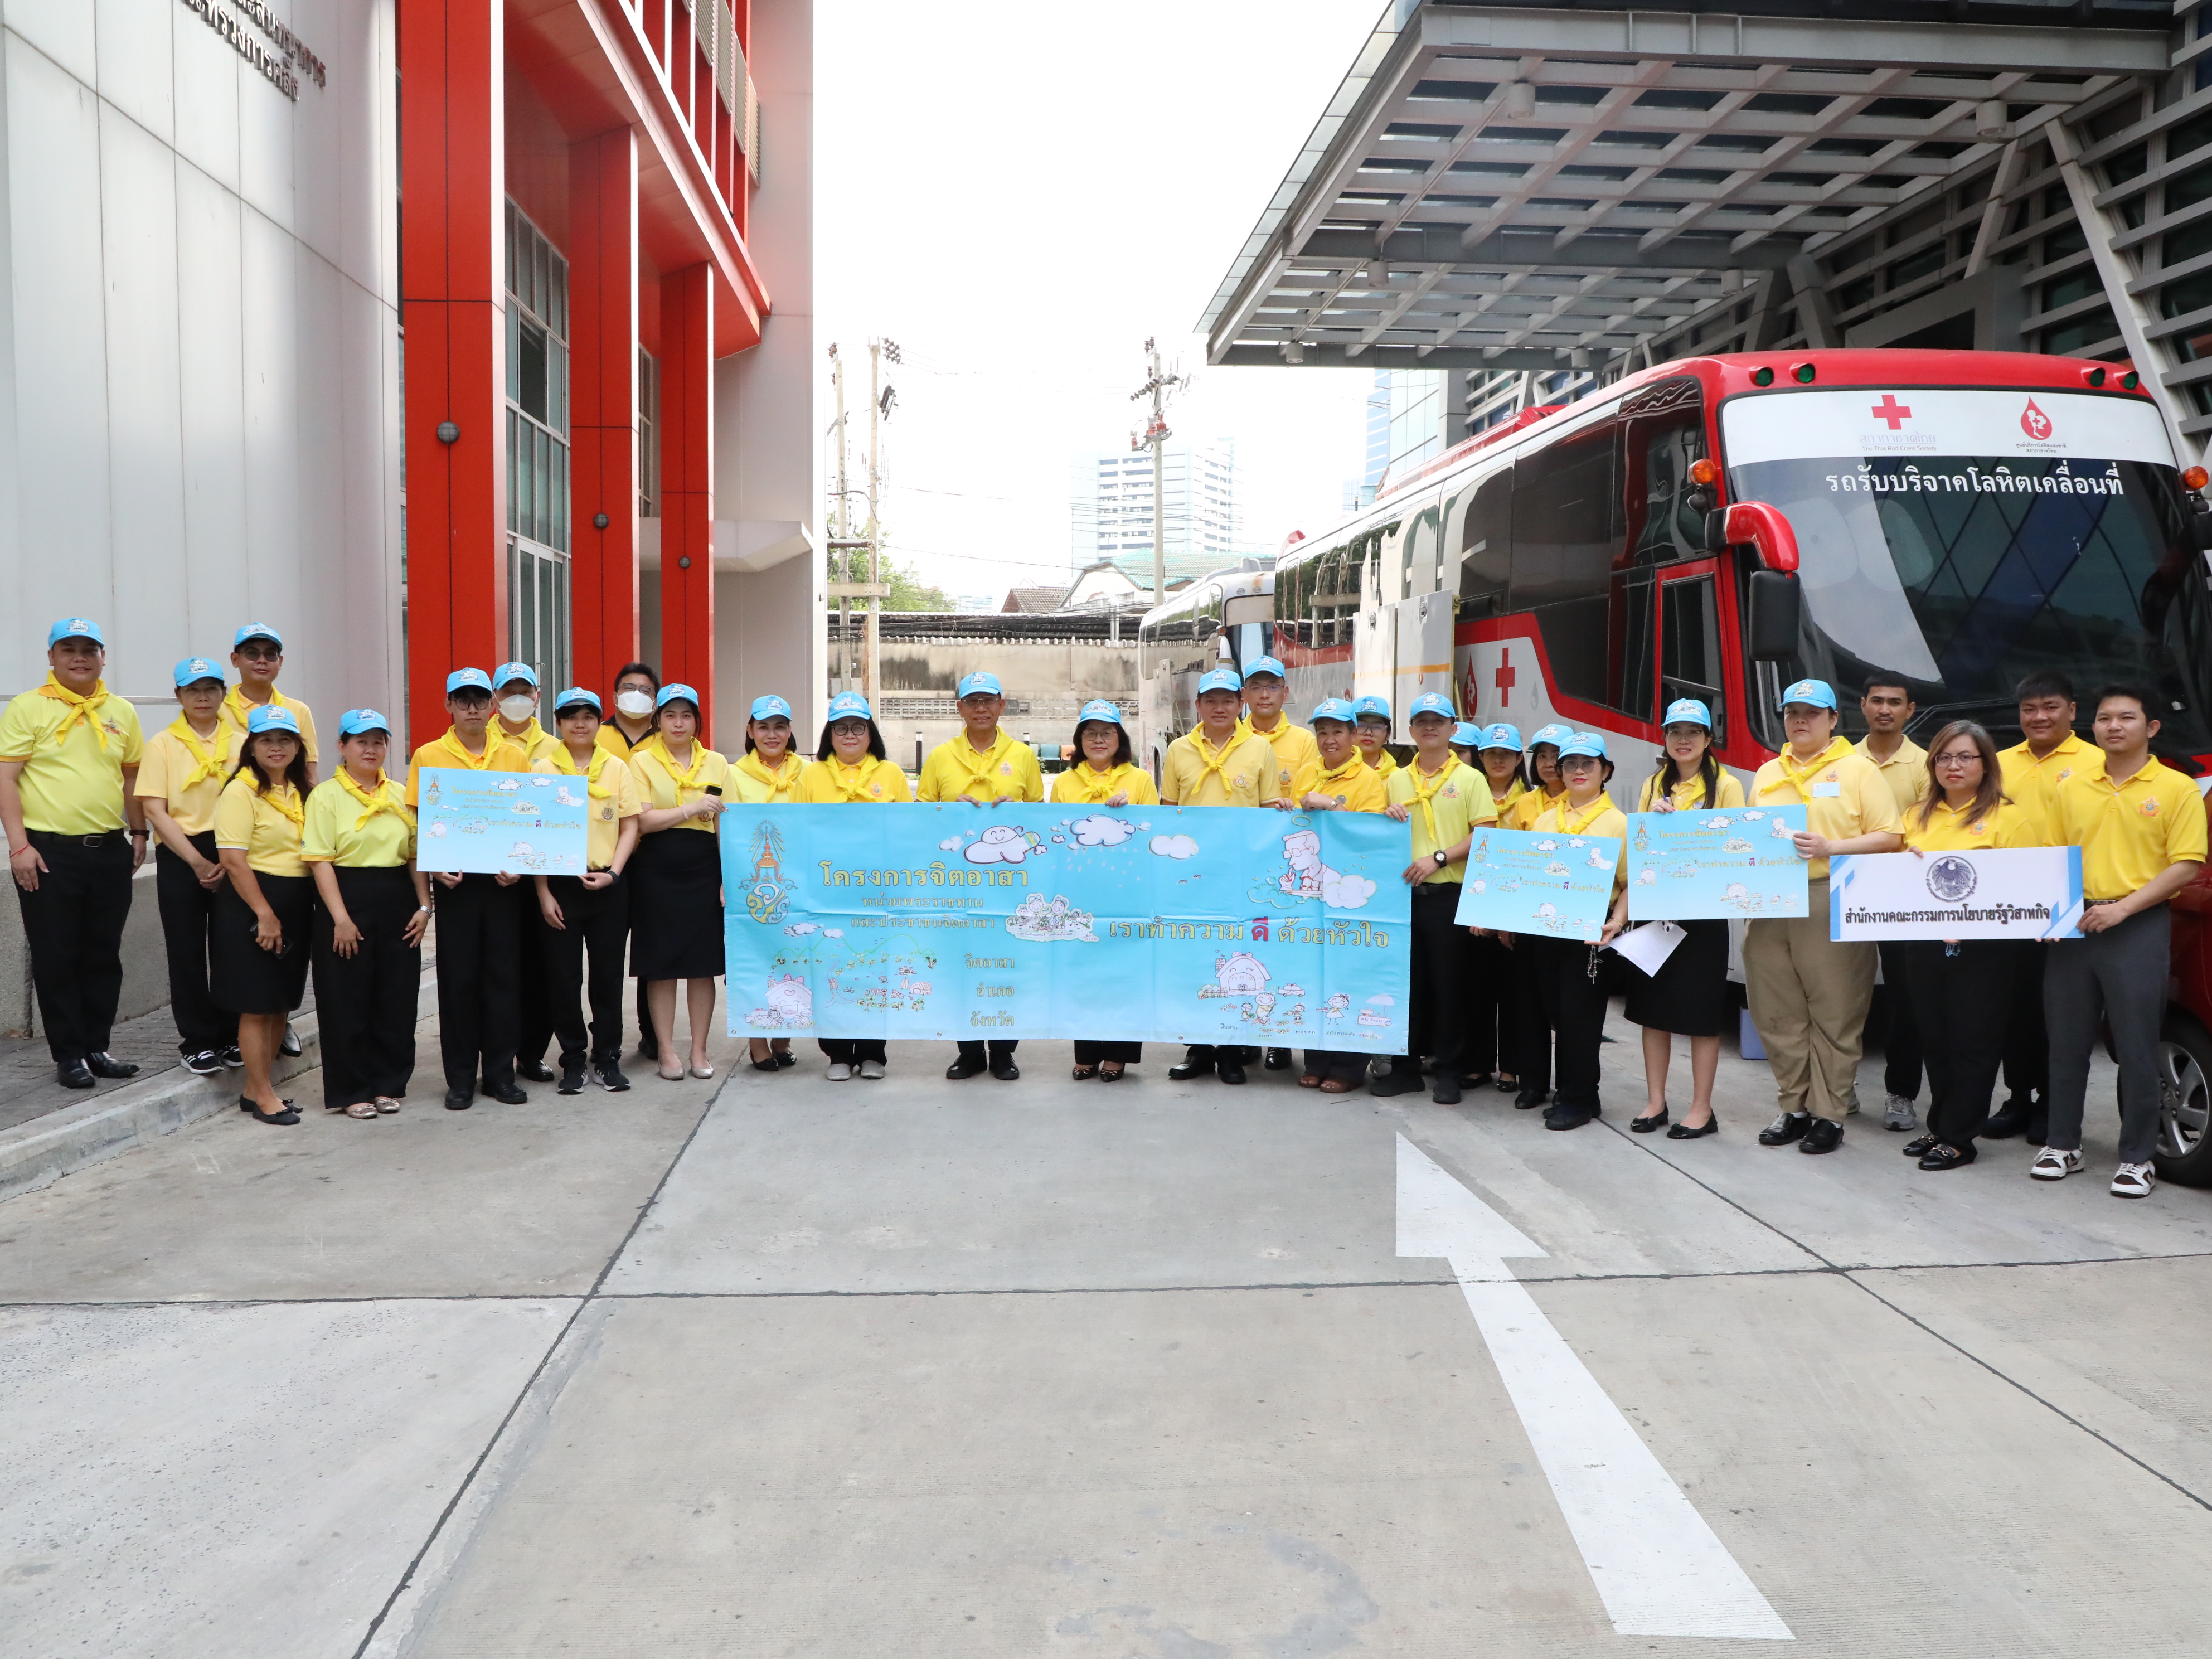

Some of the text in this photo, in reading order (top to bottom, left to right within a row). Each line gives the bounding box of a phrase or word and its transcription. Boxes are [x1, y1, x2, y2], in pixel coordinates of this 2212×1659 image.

[1860, 431, 1936, 443] สภากาชาดไทย
[1826, 460, 2123, 495] รถรับบริจาคโลหิตเคลื่อนที่
[1749, 857, 1755, 866] ดี
[818, 860, 1028, 886] โครงการจิตอาสา
[1563, 881, 1569, 890] ดี
[861, 892, 983, 908] หน่วยพระราชทาน
[851, 913, 995, 928] และประชาชนจิตอาสา
[1845, 903, 2050, 924] สำนักงานคณะกรรมการนโยบายรัฐวิสาหกิจ
[1109, 916, 1389, 948] เราทำความ ดี ด้วยหัวใจ
[964, 953, 1015, 968] จิตอาสา
[976, 982, 1015, 997] อำเภอ
[970, 1010, 1015, 1026] จังหวัด
